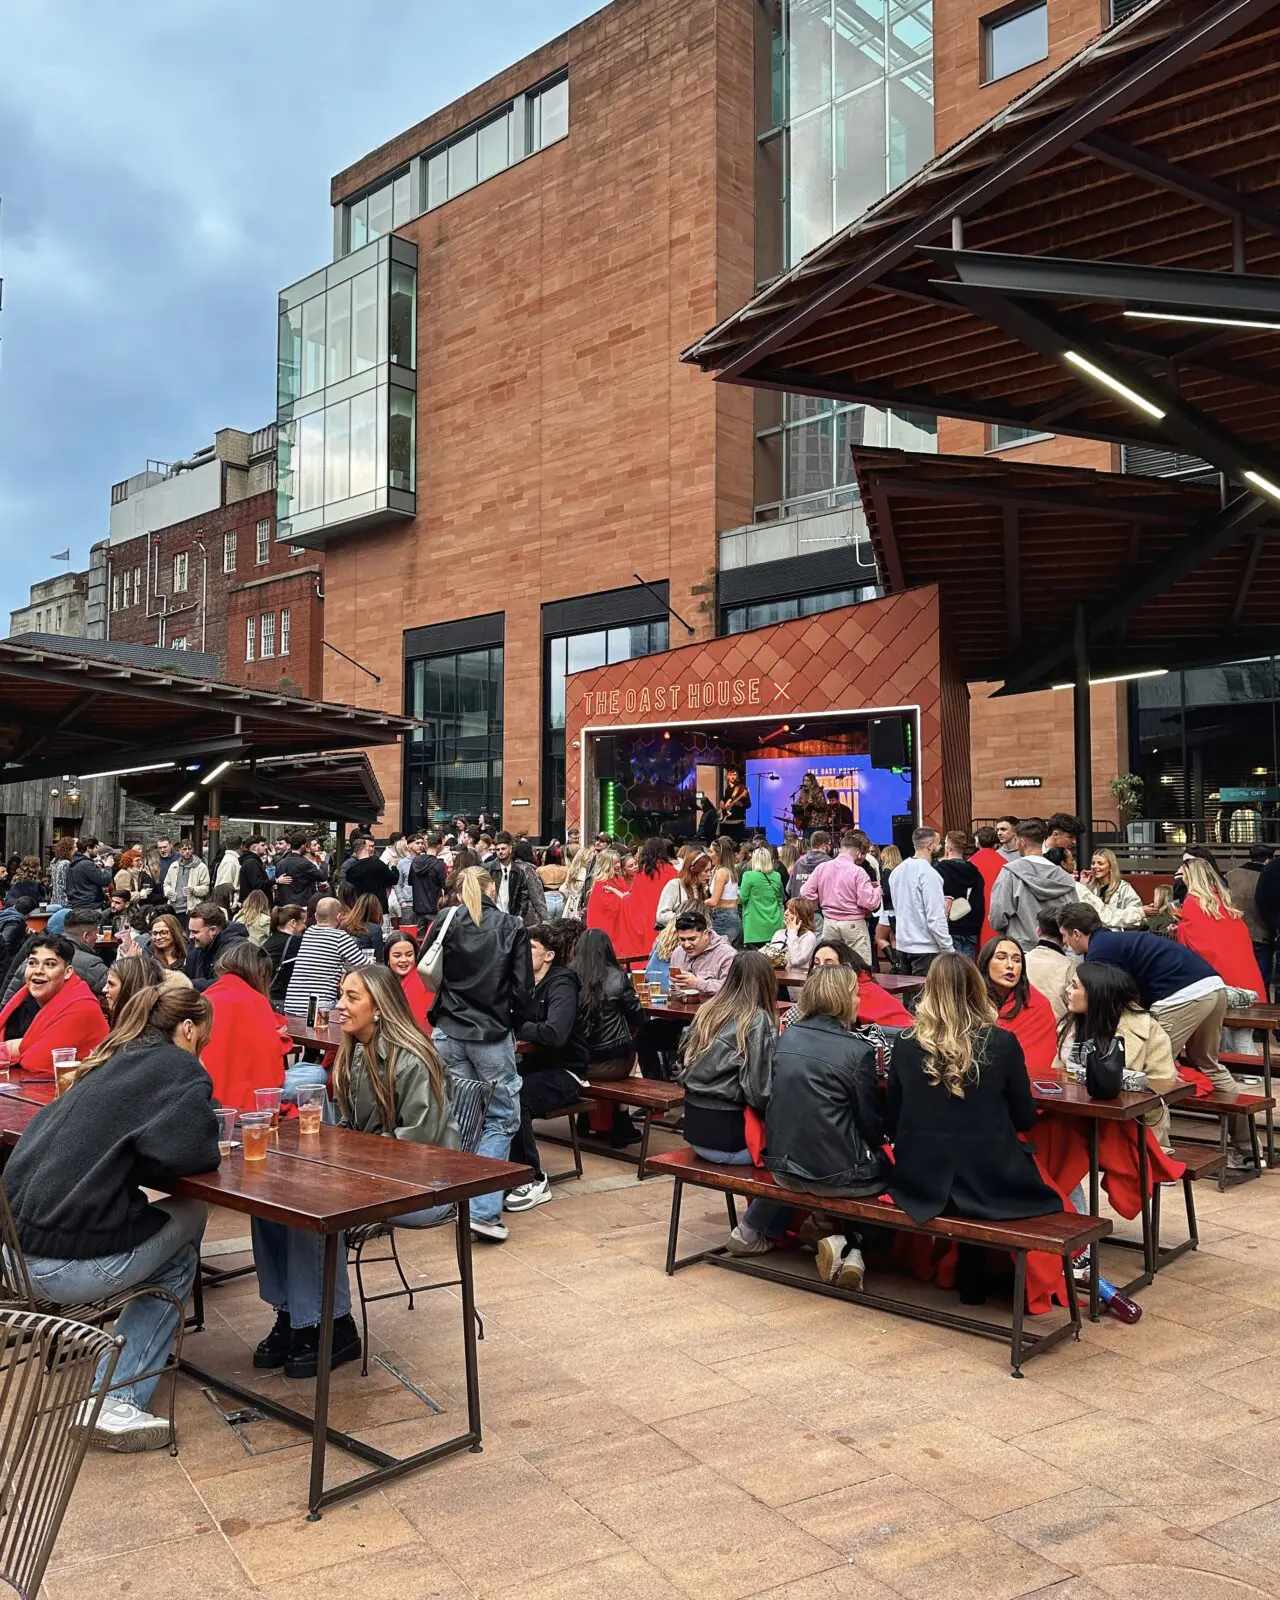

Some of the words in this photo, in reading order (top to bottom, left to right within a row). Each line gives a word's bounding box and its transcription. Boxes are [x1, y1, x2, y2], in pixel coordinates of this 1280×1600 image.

[584, 691, 619, 715] THE
[625, 686, 681, 713] OAST
[688, 678, 760, 709] HOUSE
[821, 767, 836, 775] OAST
[1005, 779, 1040, 787] FLANNELS
